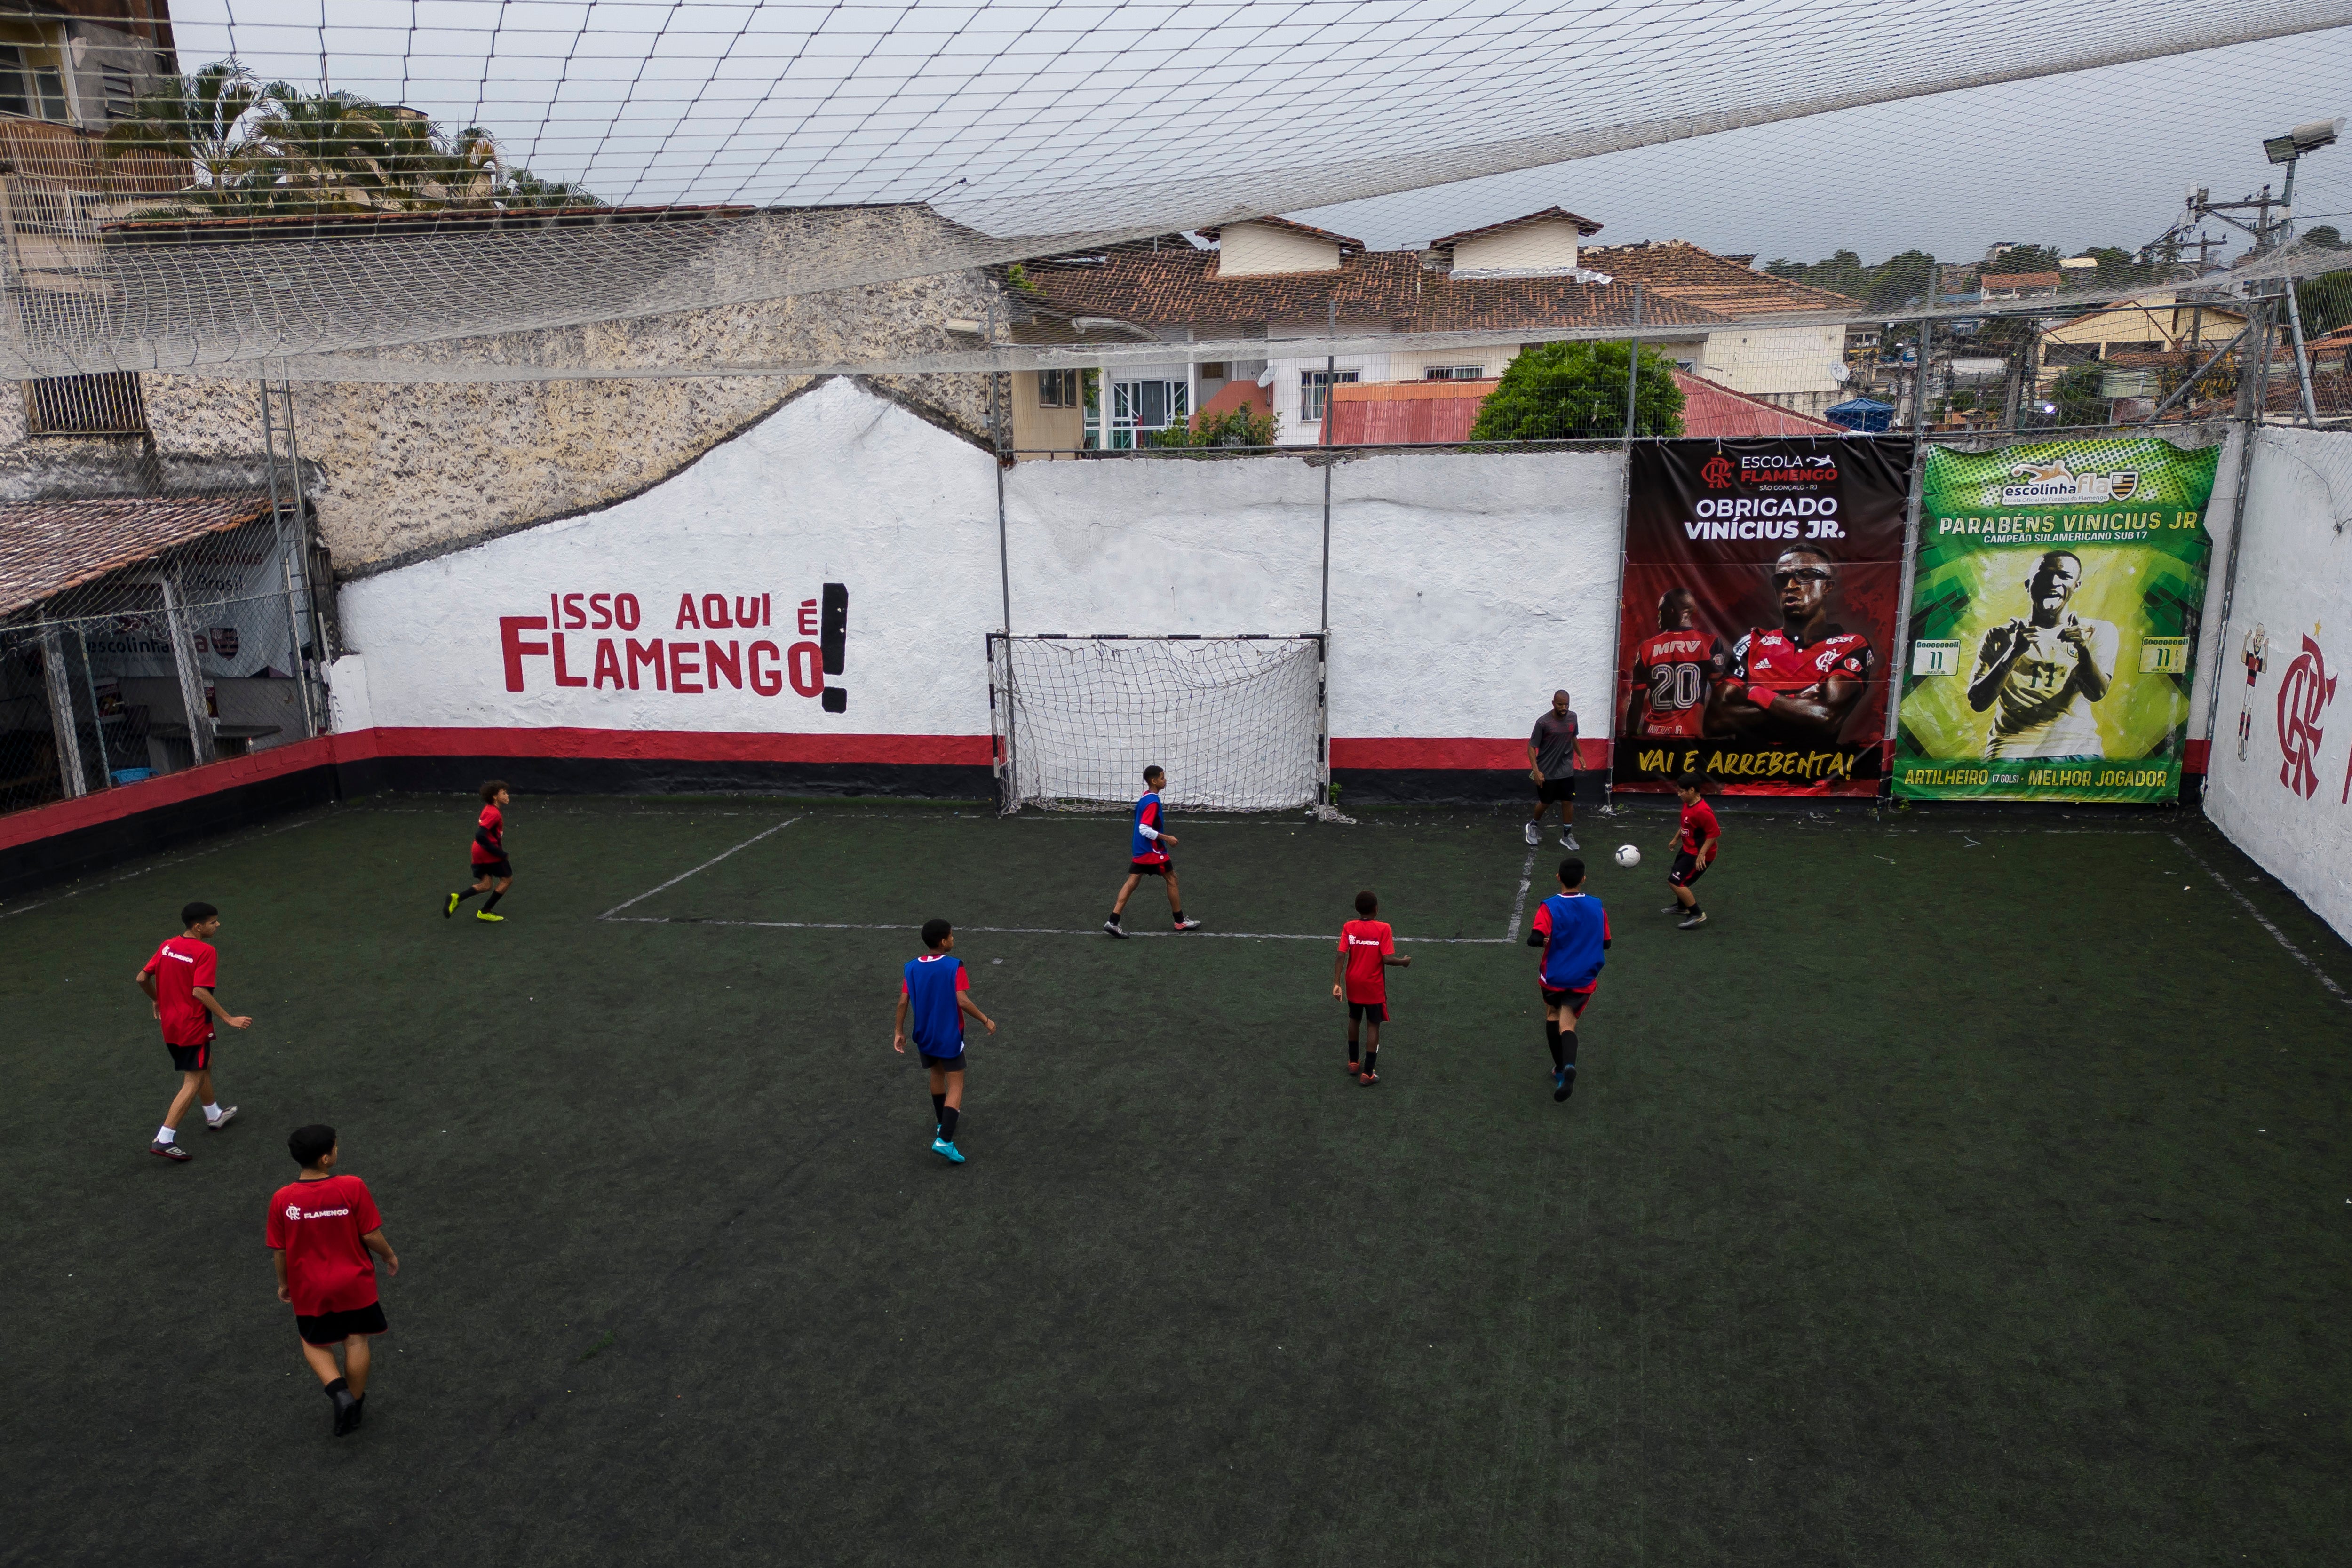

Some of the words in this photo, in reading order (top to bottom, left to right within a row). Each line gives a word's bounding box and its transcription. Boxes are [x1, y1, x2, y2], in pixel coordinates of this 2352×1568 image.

[1741, 455, 1803, 468] ESCOLA
[1741, 469, 1838, 482] FLAMENGO
[2005, 483, 2076, 496] escolinha
[1696, 497, 1838, 517] OBRIGADO
[1684, 517, 1799, 540] VINÍCIUS
[1804, 520, 1846, 539] JR.
[1939, 513, 2055, 534] PARABÉNS
[2063, 511, 2162, 532] VINICIUS
[2168, 510, 2199, 530] JR
[1983, 533, 2032, 543] CAMPEÃO
[2034, 532, 2112, 543] SULAMERICANO
[551, 593, 640, 631] ISSO
[675, 592, 771, 630] AQUI
[797, 598, 818, 636] É
[86, 637, 169, 653] escolinha
[1653, 640, 1701, 657] MRV
[1930, 651, 1943, 669] 11
[2157, 648, 2170, 667] 11
[1651, 663, 1701, 710] 20
[1638, 749, 1674, 773] VAI
[1683, 750, 1699, 773] E
[1706, 750, 1854, 780] ARREBENTA!
[1904, 769, 1989, 785] ARTILHEIRO
[2028, 769, 2092, 787] MELHOR
[2095, 770, 2167, 787] JOGADOR
[304, 1208, 349, 1219] FLAMENGO
